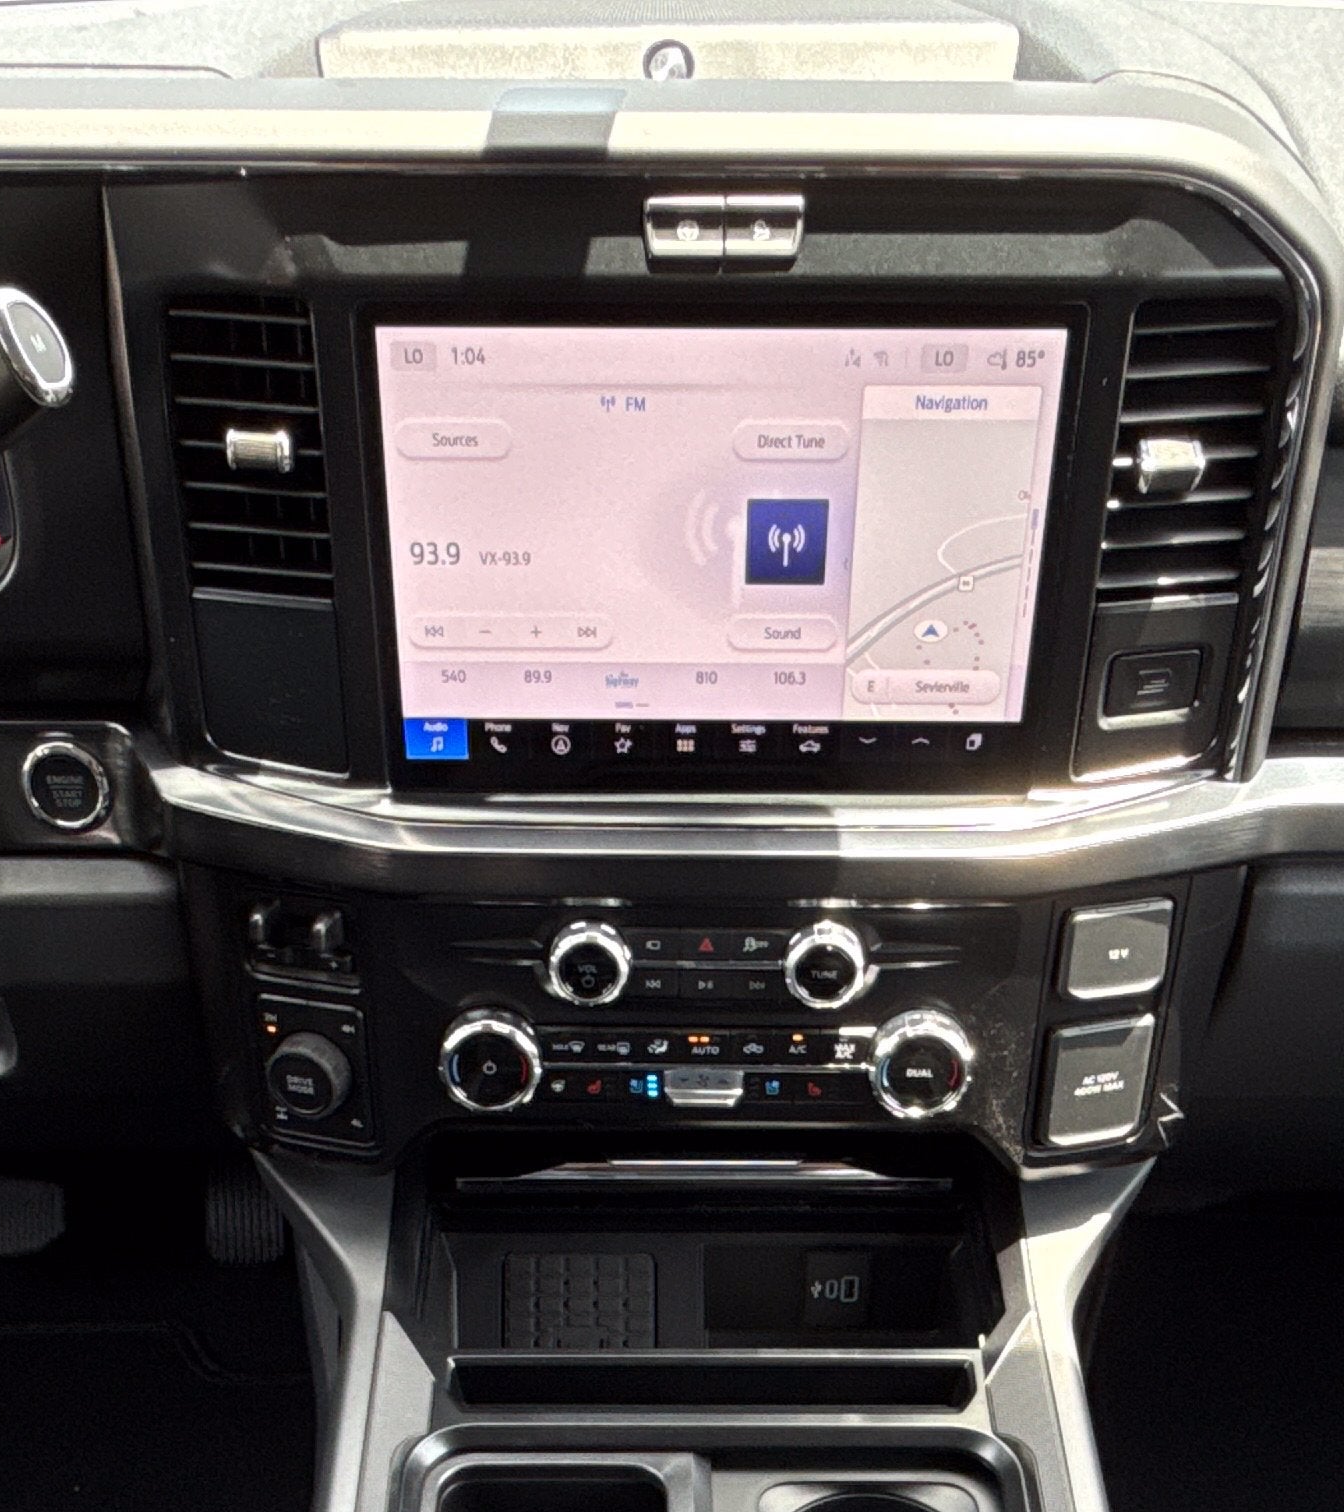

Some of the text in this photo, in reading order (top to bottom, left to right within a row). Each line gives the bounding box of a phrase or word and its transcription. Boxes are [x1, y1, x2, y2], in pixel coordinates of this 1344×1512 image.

[404, 348, 424, 365] LO
[451, 347, 486, 365] 1:04
[934, 350, 955, 366] LO
[624, 396, 647, 412] FM
[914, 395, 988, 413] Navigation
[432, 432, 479, 448] Sources
[757, 434, 826, 450] Direct Tune
[409, 541, 461, 566] 93.9
[478, 551, 532, 566] VX-93.9
[763, 626, 802, 640] Sound
[441, 669, 467, 684] 540
[523, 669, 553, 684] 89.9
[695, 670, 718, 685] 810
[773, 670, 807, 686] 106.3
[867, 680, 875, 693] E
[915, 680, 971, 694] Sevierville
[423, 721, 449, 733] Audio
[484, 721, 512, 733] Phone
[552, 721, 570, 733] Nav
[614, 721, 632, 733] Fav
[674, 723, 697, 736] Apps
[731, 722, 766, 735] Settings
[792, 722, 830, 735] Features
[577, 963, 598, 975] VOL
[811, 968, 838, 981] TUNE
[690, 1045, 720, 1056] AUTO
[906, 1067, 934, 1079] DUAL
